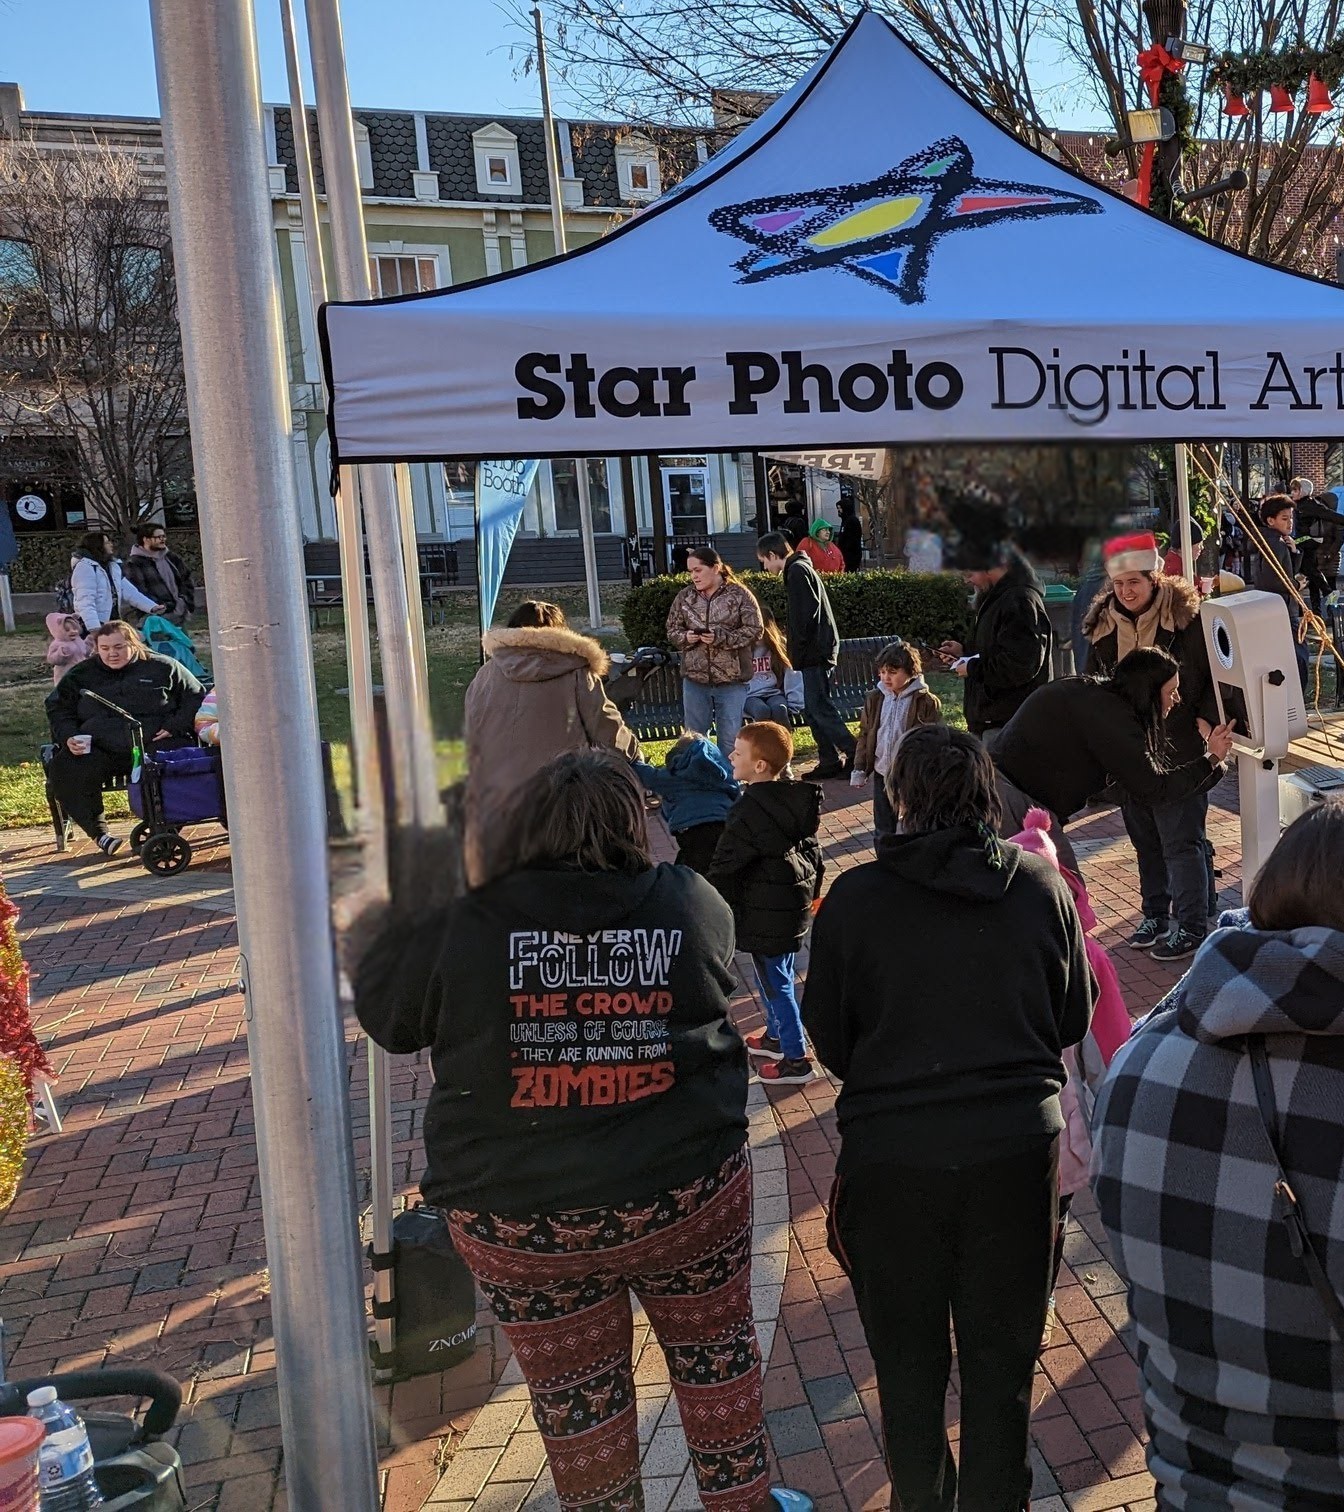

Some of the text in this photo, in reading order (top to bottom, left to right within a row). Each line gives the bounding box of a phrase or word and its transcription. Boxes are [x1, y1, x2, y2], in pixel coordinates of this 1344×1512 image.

[514, 352, 697, 420] Star
[725, 349, 964, 415] Photo
[988, 346, 1227, 426] Digital
[483, 467, 527, 497] Booth
[541, 929, 632, 945] I NEVER
[509, 928, 683, 990] FOLLOW
[509, 991, 673, 1018] THE CROWD
[510, 1019, 671, 1043] UNLESS OF COURSE
[521, 1043, 668, 1062] THEY ARE RUNNING FROM
[510, 1061, 676, 1109] ZOMBIES
